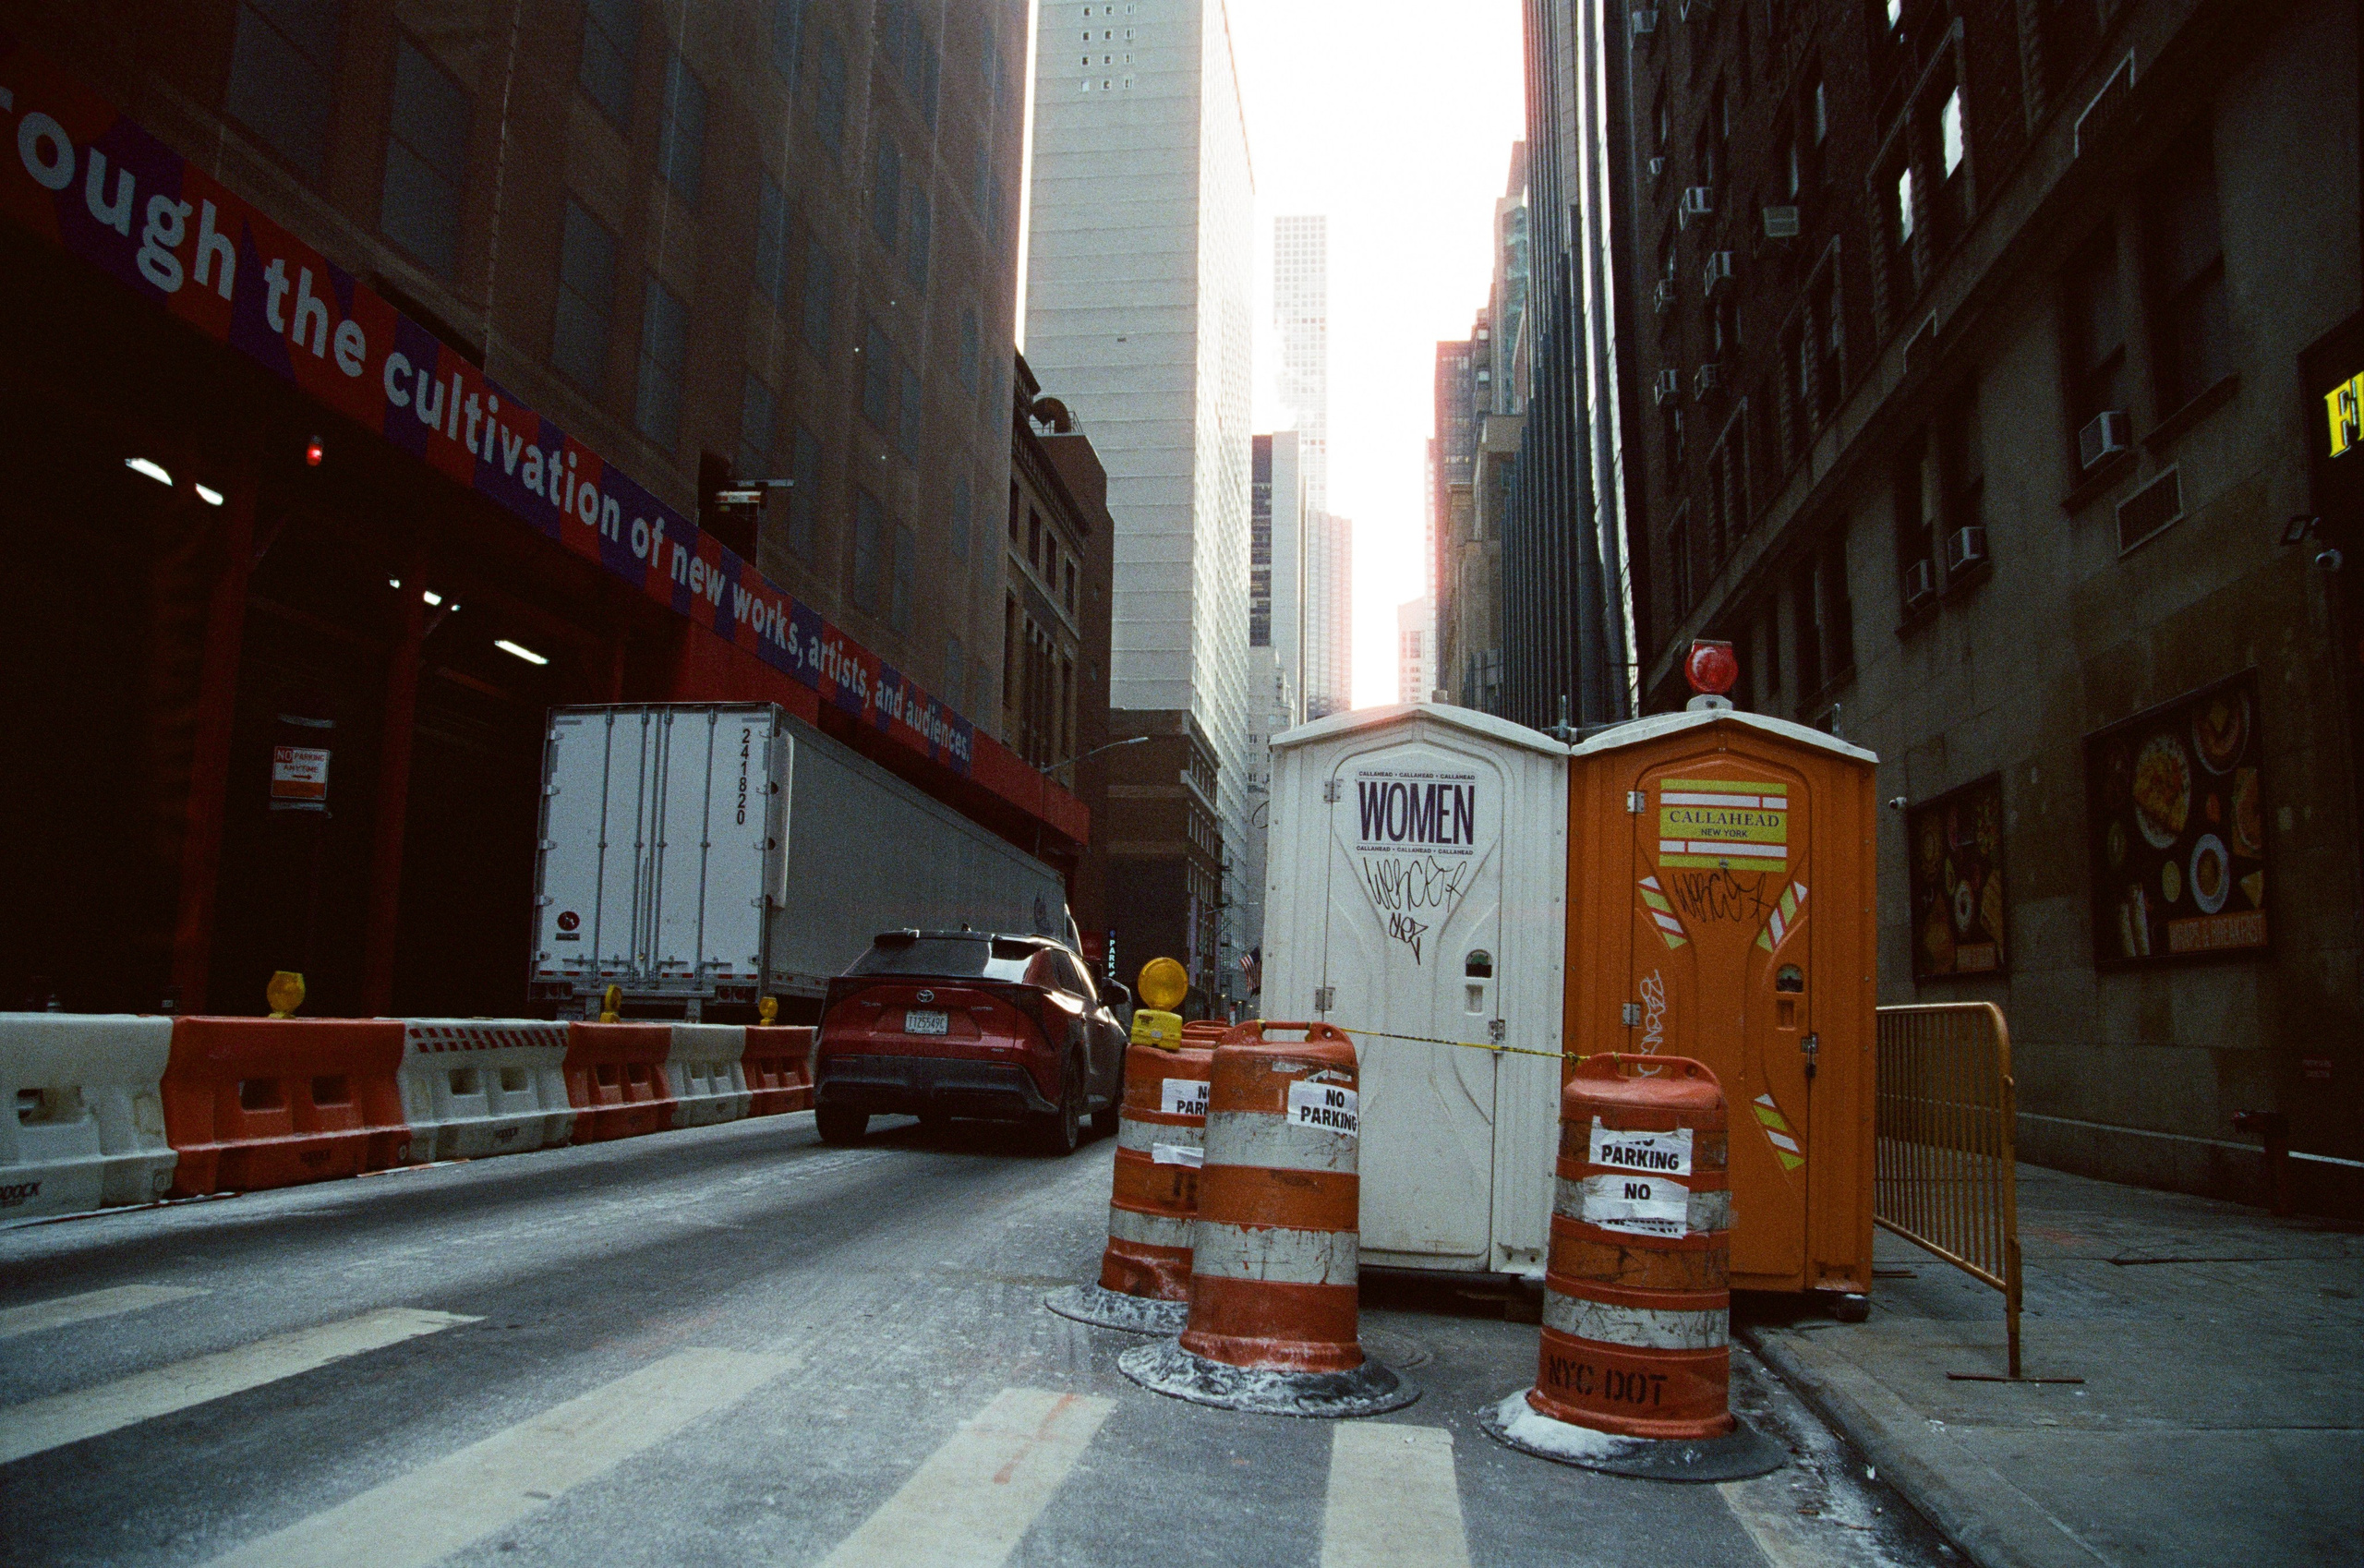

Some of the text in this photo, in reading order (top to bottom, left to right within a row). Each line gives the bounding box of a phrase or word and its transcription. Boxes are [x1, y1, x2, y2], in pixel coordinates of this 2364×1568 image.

[0, 85, 970, 763] ough the cultivation of new works, artists, and audiences.
[277, 750, 324, 762] NO PARKING
[283, 765, 318, 773] ANYTIME
[1358, 781, 1475, 845] WOMEN
[1669, 810, 1780, 828] CALLAHEAD
[1701, 828, 1748, 838] NEW YORK
[1326, 1089, 1345, 1108] NO
[1300, 1106, 1357, 1132] PARKING
[1601, 1145, 1679, 1170] PARKING
[1624, 1183, 1651, 1200] NO
[1549, 1354, 1668, 1405] NYC DOT
